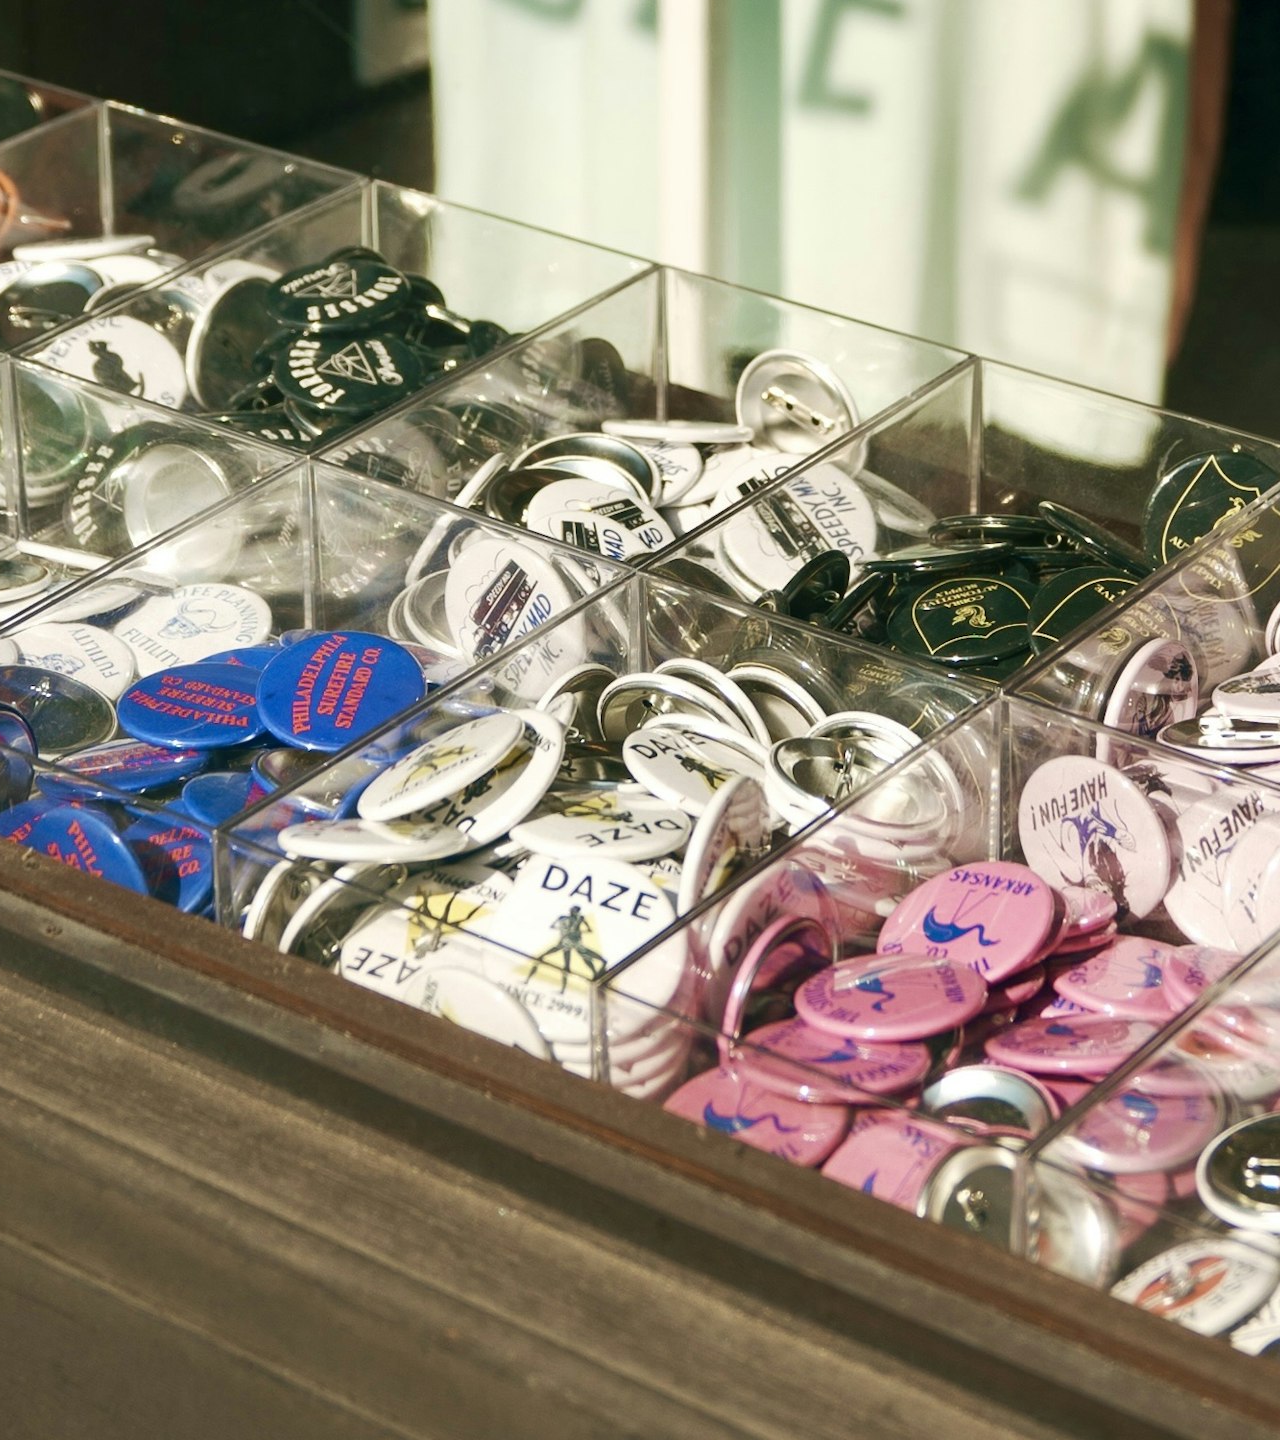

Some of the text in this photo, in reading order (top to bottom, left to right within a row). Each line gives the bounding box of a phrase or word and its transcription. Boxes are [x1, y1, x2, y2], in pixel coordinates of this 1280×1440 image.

[821, 480, 858, 513] INC.
[803, 499, 865, 562] SPEEDY
[528, 593, 553, 628] MAD
[291, 633, 349, 736] PHILADELPHIA
[317, 651, 358, 716] SUREFIRE
[334, 665, 375, 730] STANDARD
[630, 728, 707, 761] DAZE
[1068, 771, 1109, 811] HAVE
[576, 817, 685, 848] DAZE
[1222, 791, 1264, 840] HAVE
[540, 863, 659, 921] DAZE
[948, 869, 1036, 897] ARKANSAS
[345, 945, 423, 986] AZE
